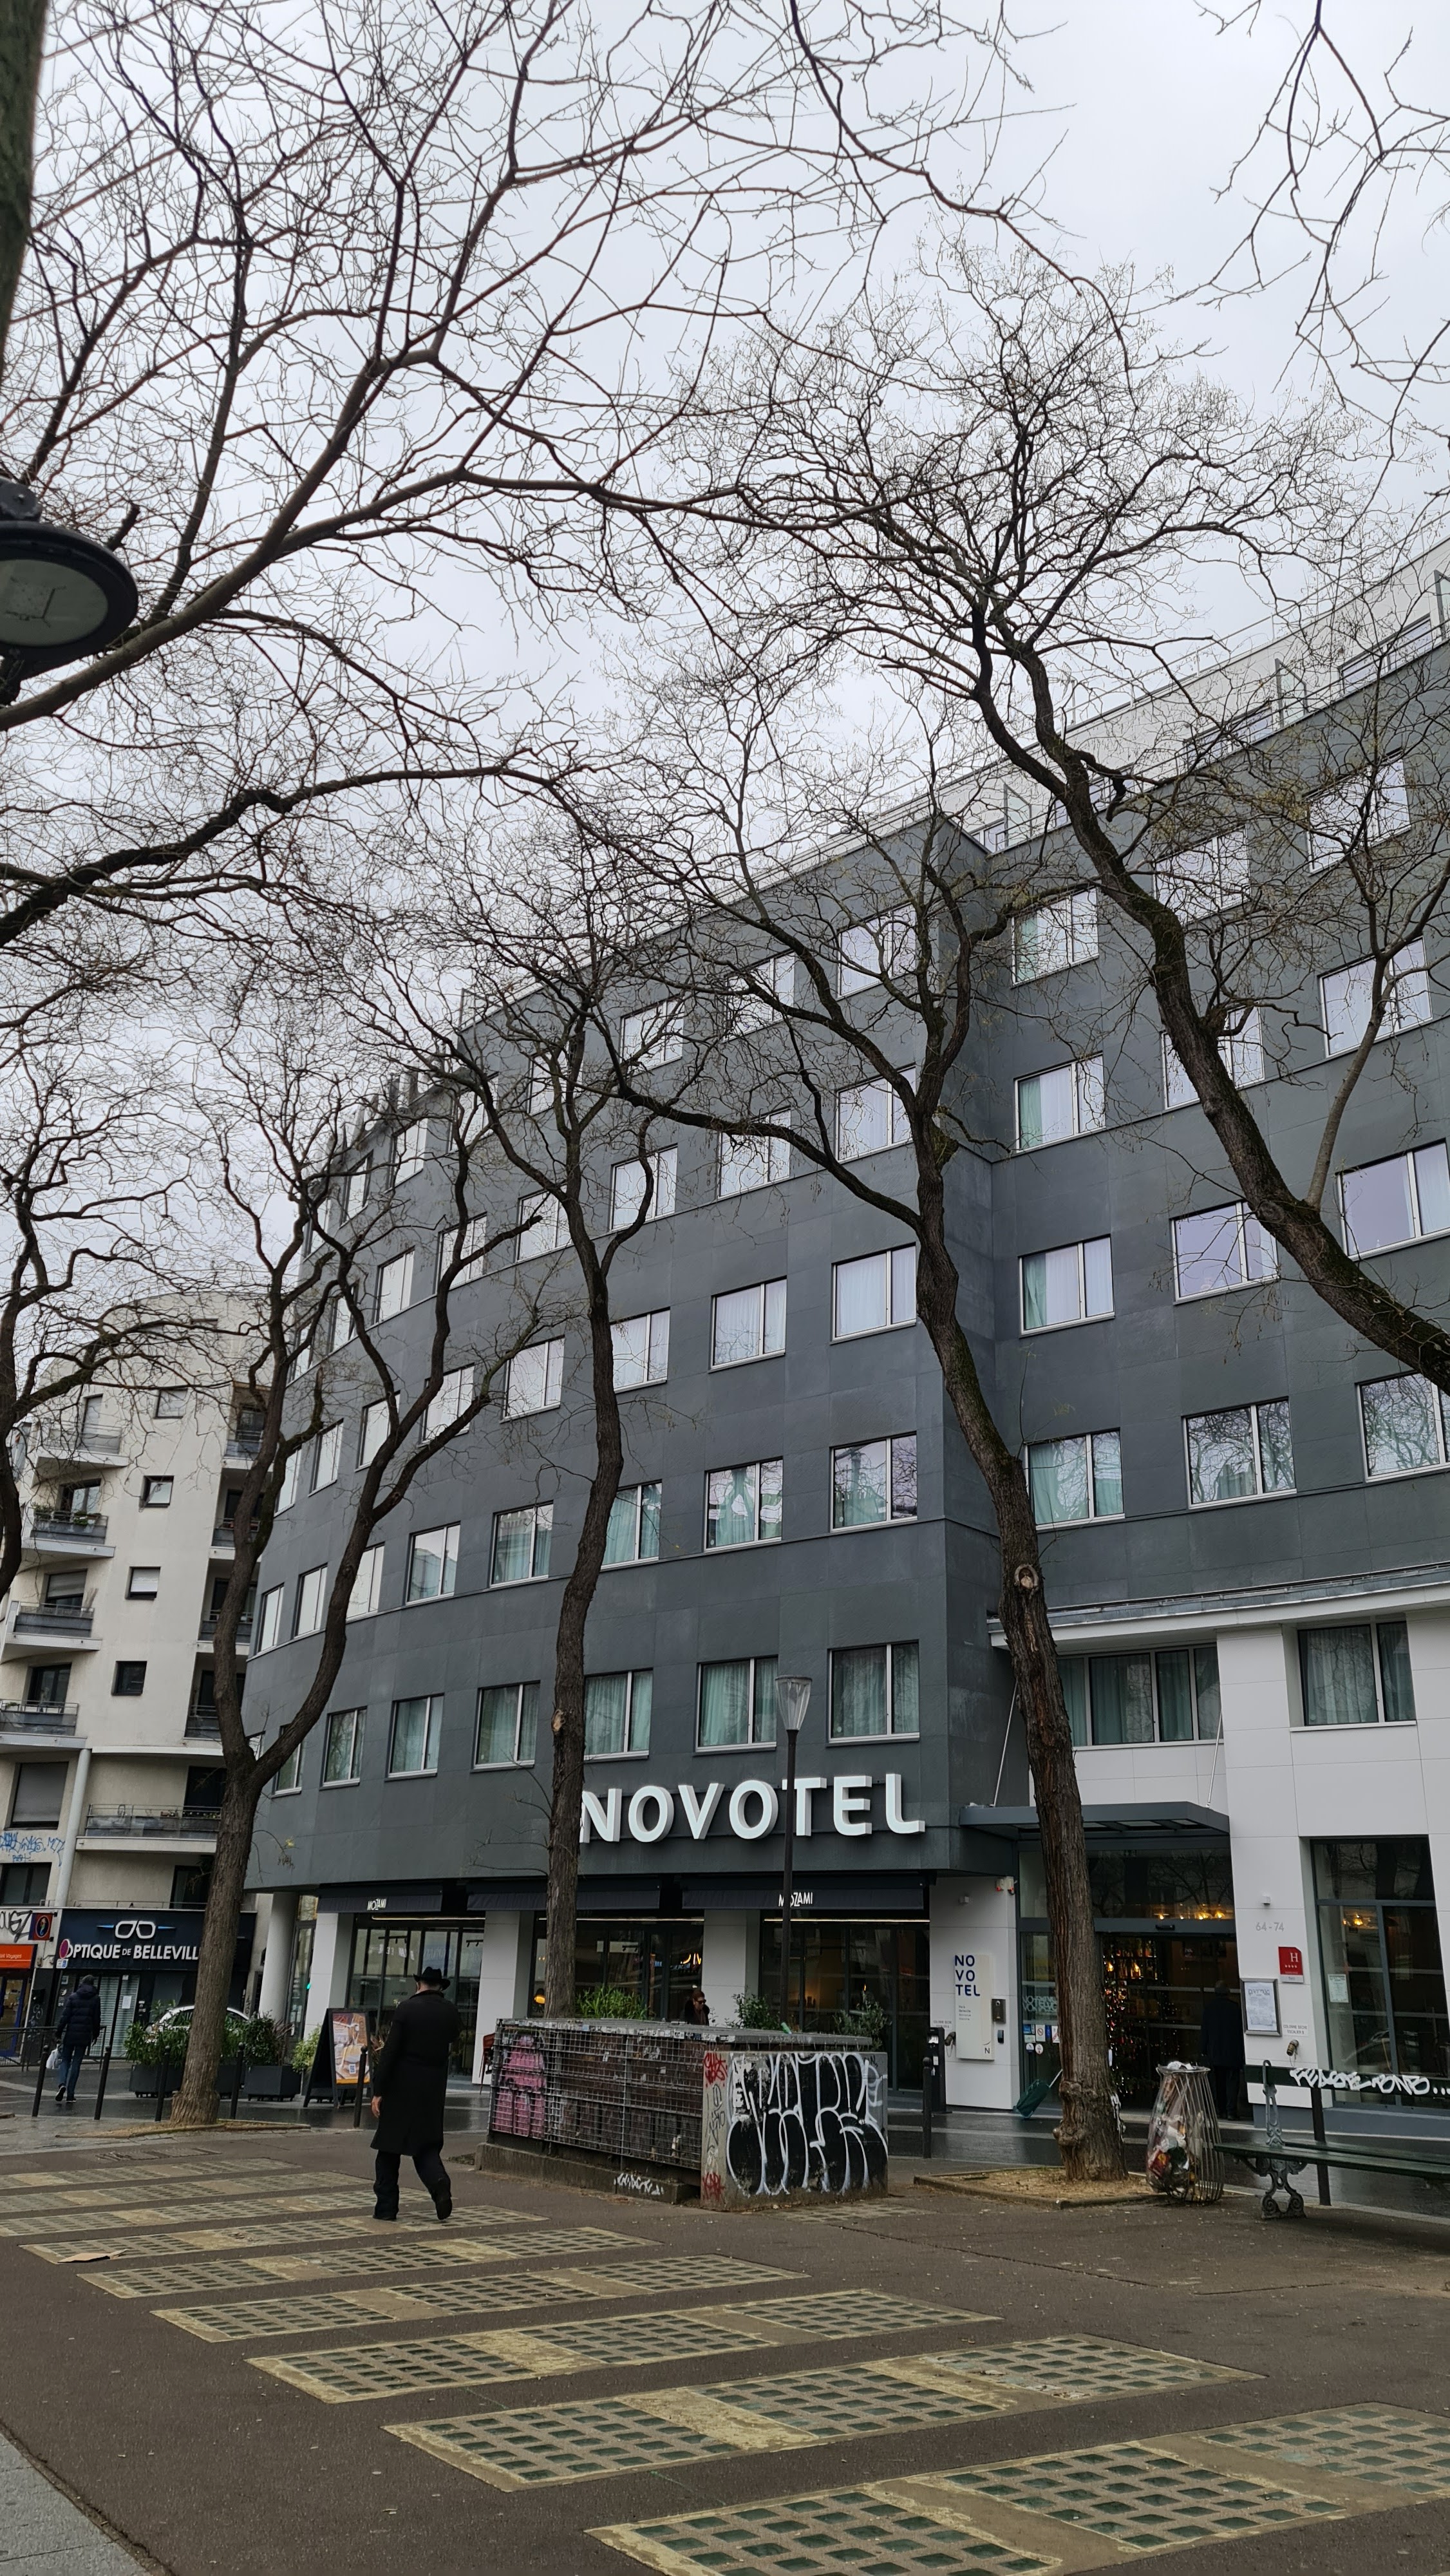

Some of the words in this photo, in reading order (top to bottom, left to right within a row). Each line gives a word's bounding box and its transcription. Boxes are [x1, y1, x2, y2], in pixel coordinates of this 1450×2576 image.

[579, 1773, 926, 1844] NOVOTEL
[133, 1944, 201, 1960] BELLEVILL
[1290, 1952, 1299, 1963] H
[954, 1955, 975, 1967] NO
[955, 1969, 975, 1982] VO
[955, 1984, 981, 1996] TEL
